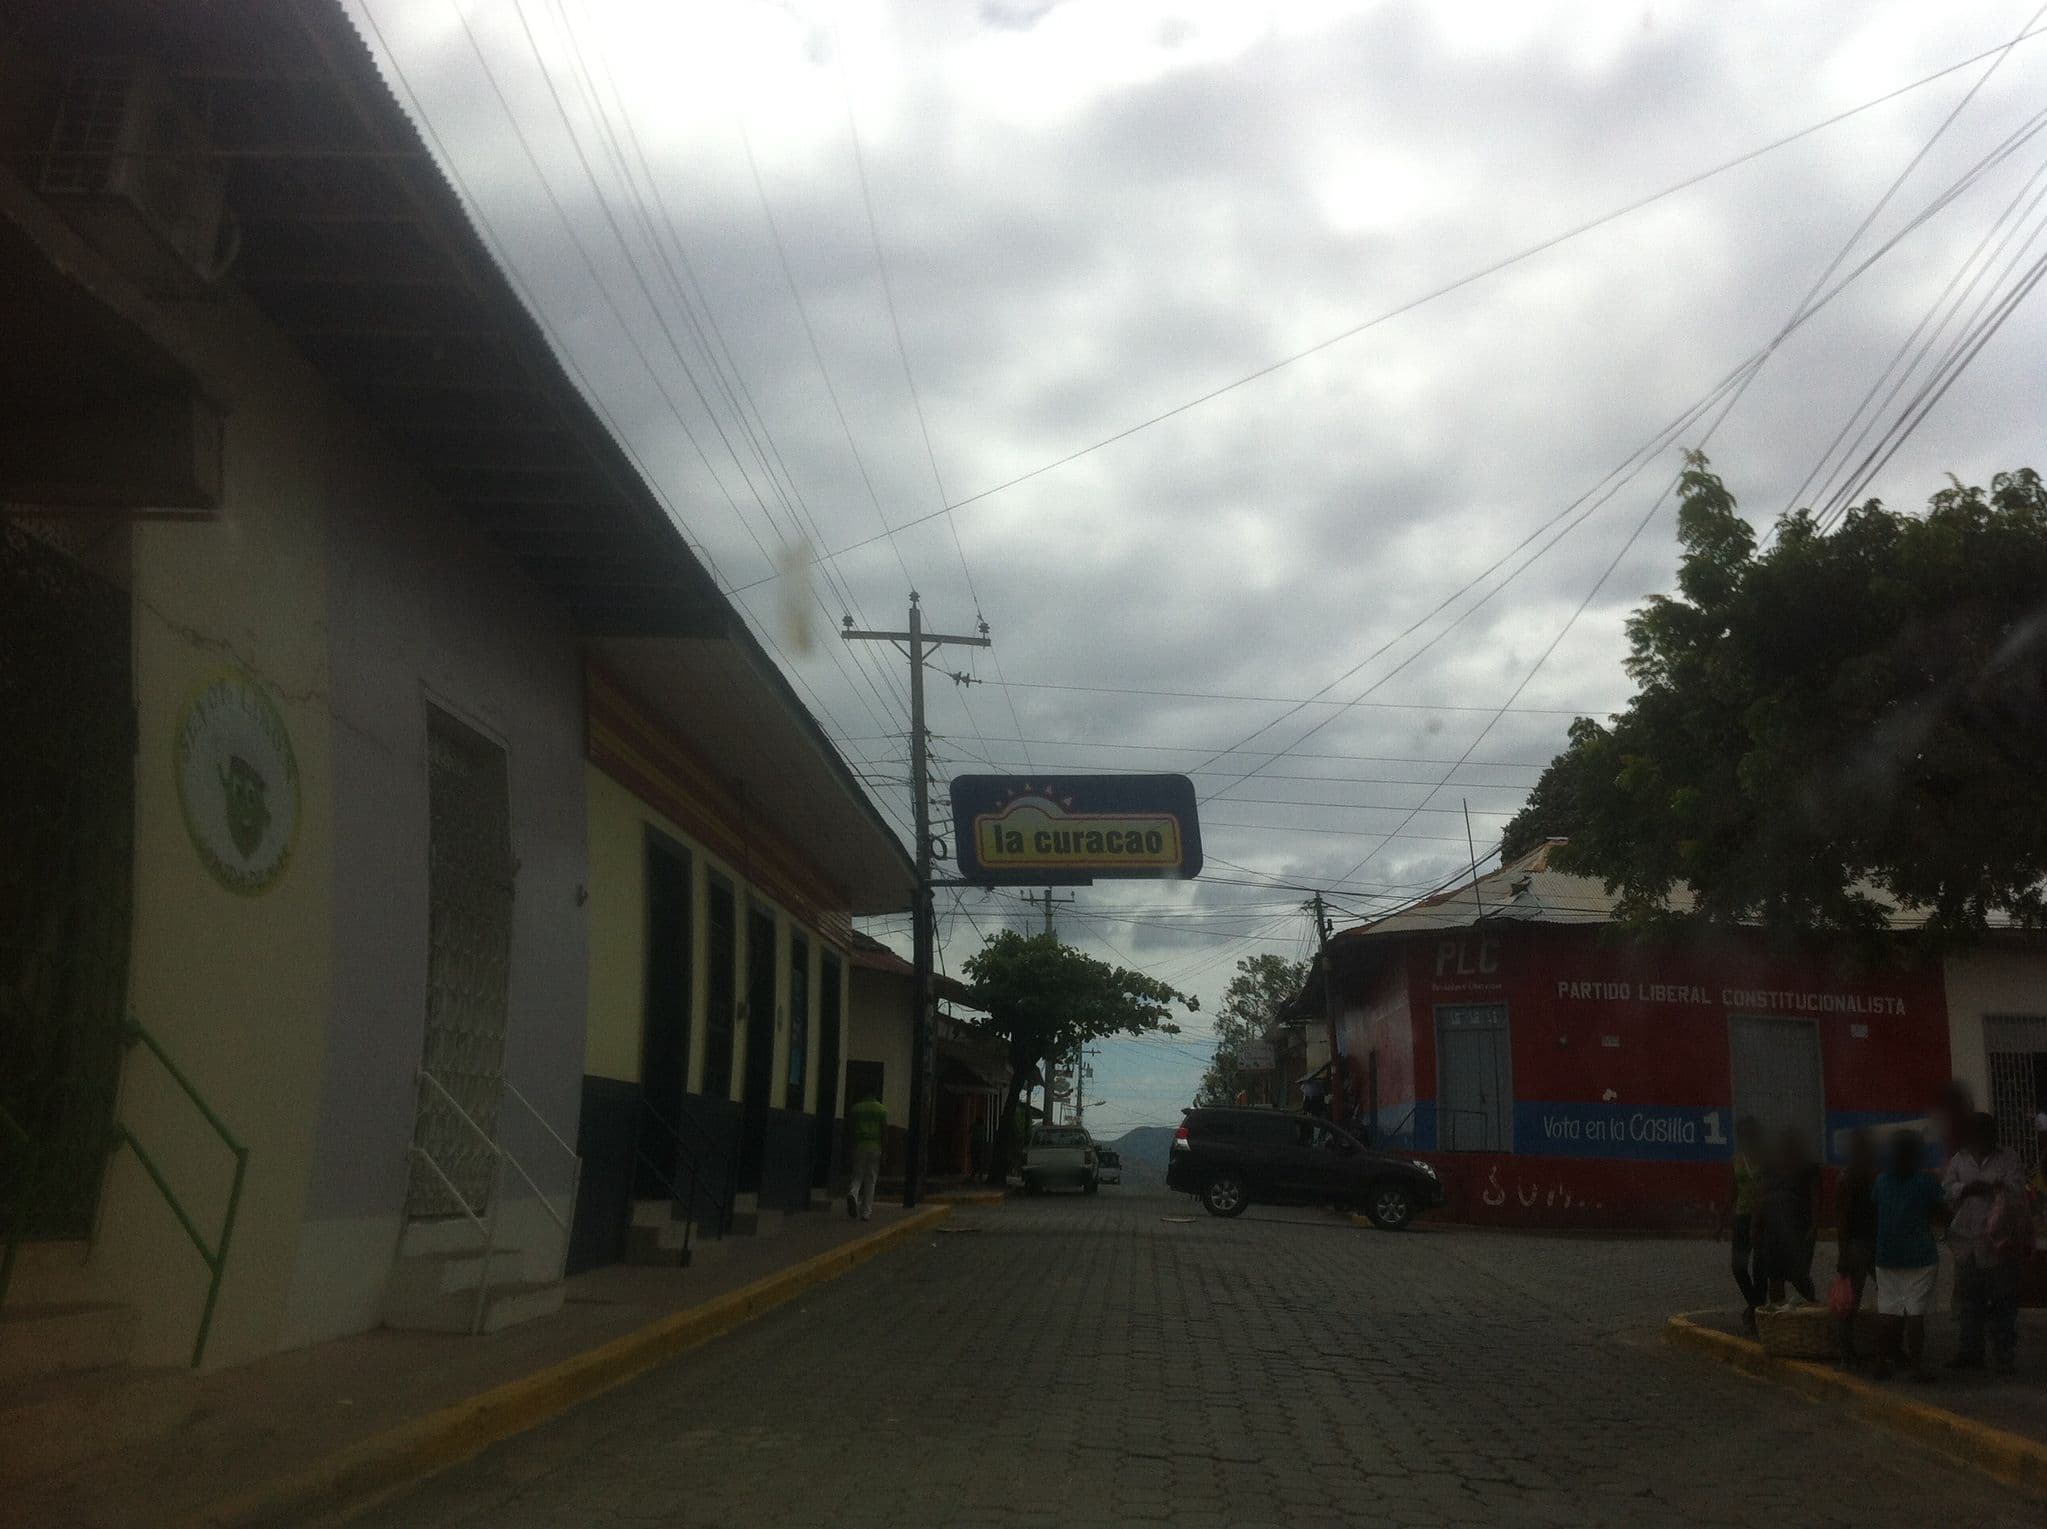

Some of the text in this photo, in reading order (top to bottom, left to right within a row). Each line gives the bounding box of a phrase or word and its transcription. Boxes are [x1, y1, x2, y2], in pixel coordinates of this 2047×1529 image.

[993, 824, 1164, 855] la curacao
[1435, 942, 1502, 976] PLC
[1557, 981, 1907, 1016] PARTIDO LIBERAL CONSTITUCIONALISTA
[1543, 1111, 1728, 1145] Vota en la Casilla 1
